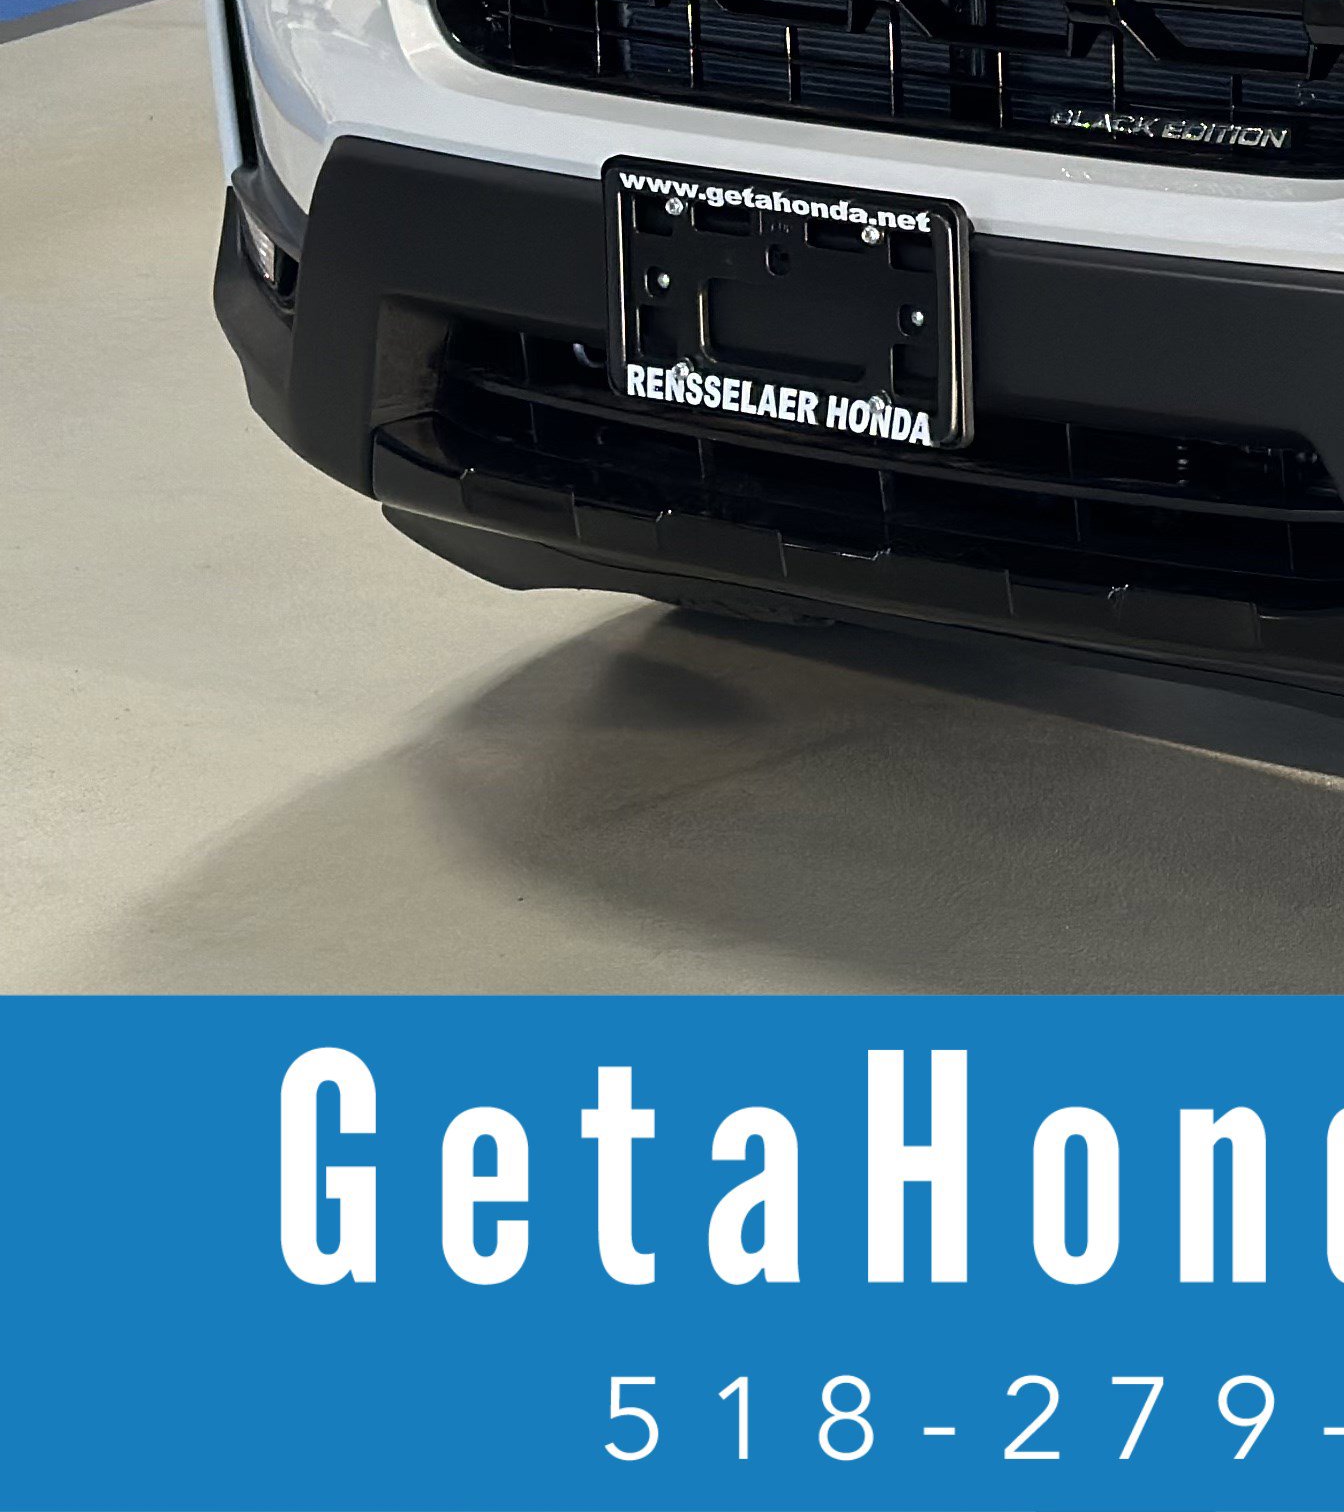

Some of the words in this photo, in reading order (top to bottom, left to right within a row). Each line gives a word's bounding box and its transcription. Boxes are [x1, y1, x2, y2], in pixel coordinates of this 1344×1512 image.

[1050, 109, 1161, 138] BLACK
[1160, 120, 1289, 149] EDITION
[618, 171, 931, 233] www.getahonda.net
[626, 363, 819, 425] RENSSELAER
[825, 394, 936, 447] HONDA
